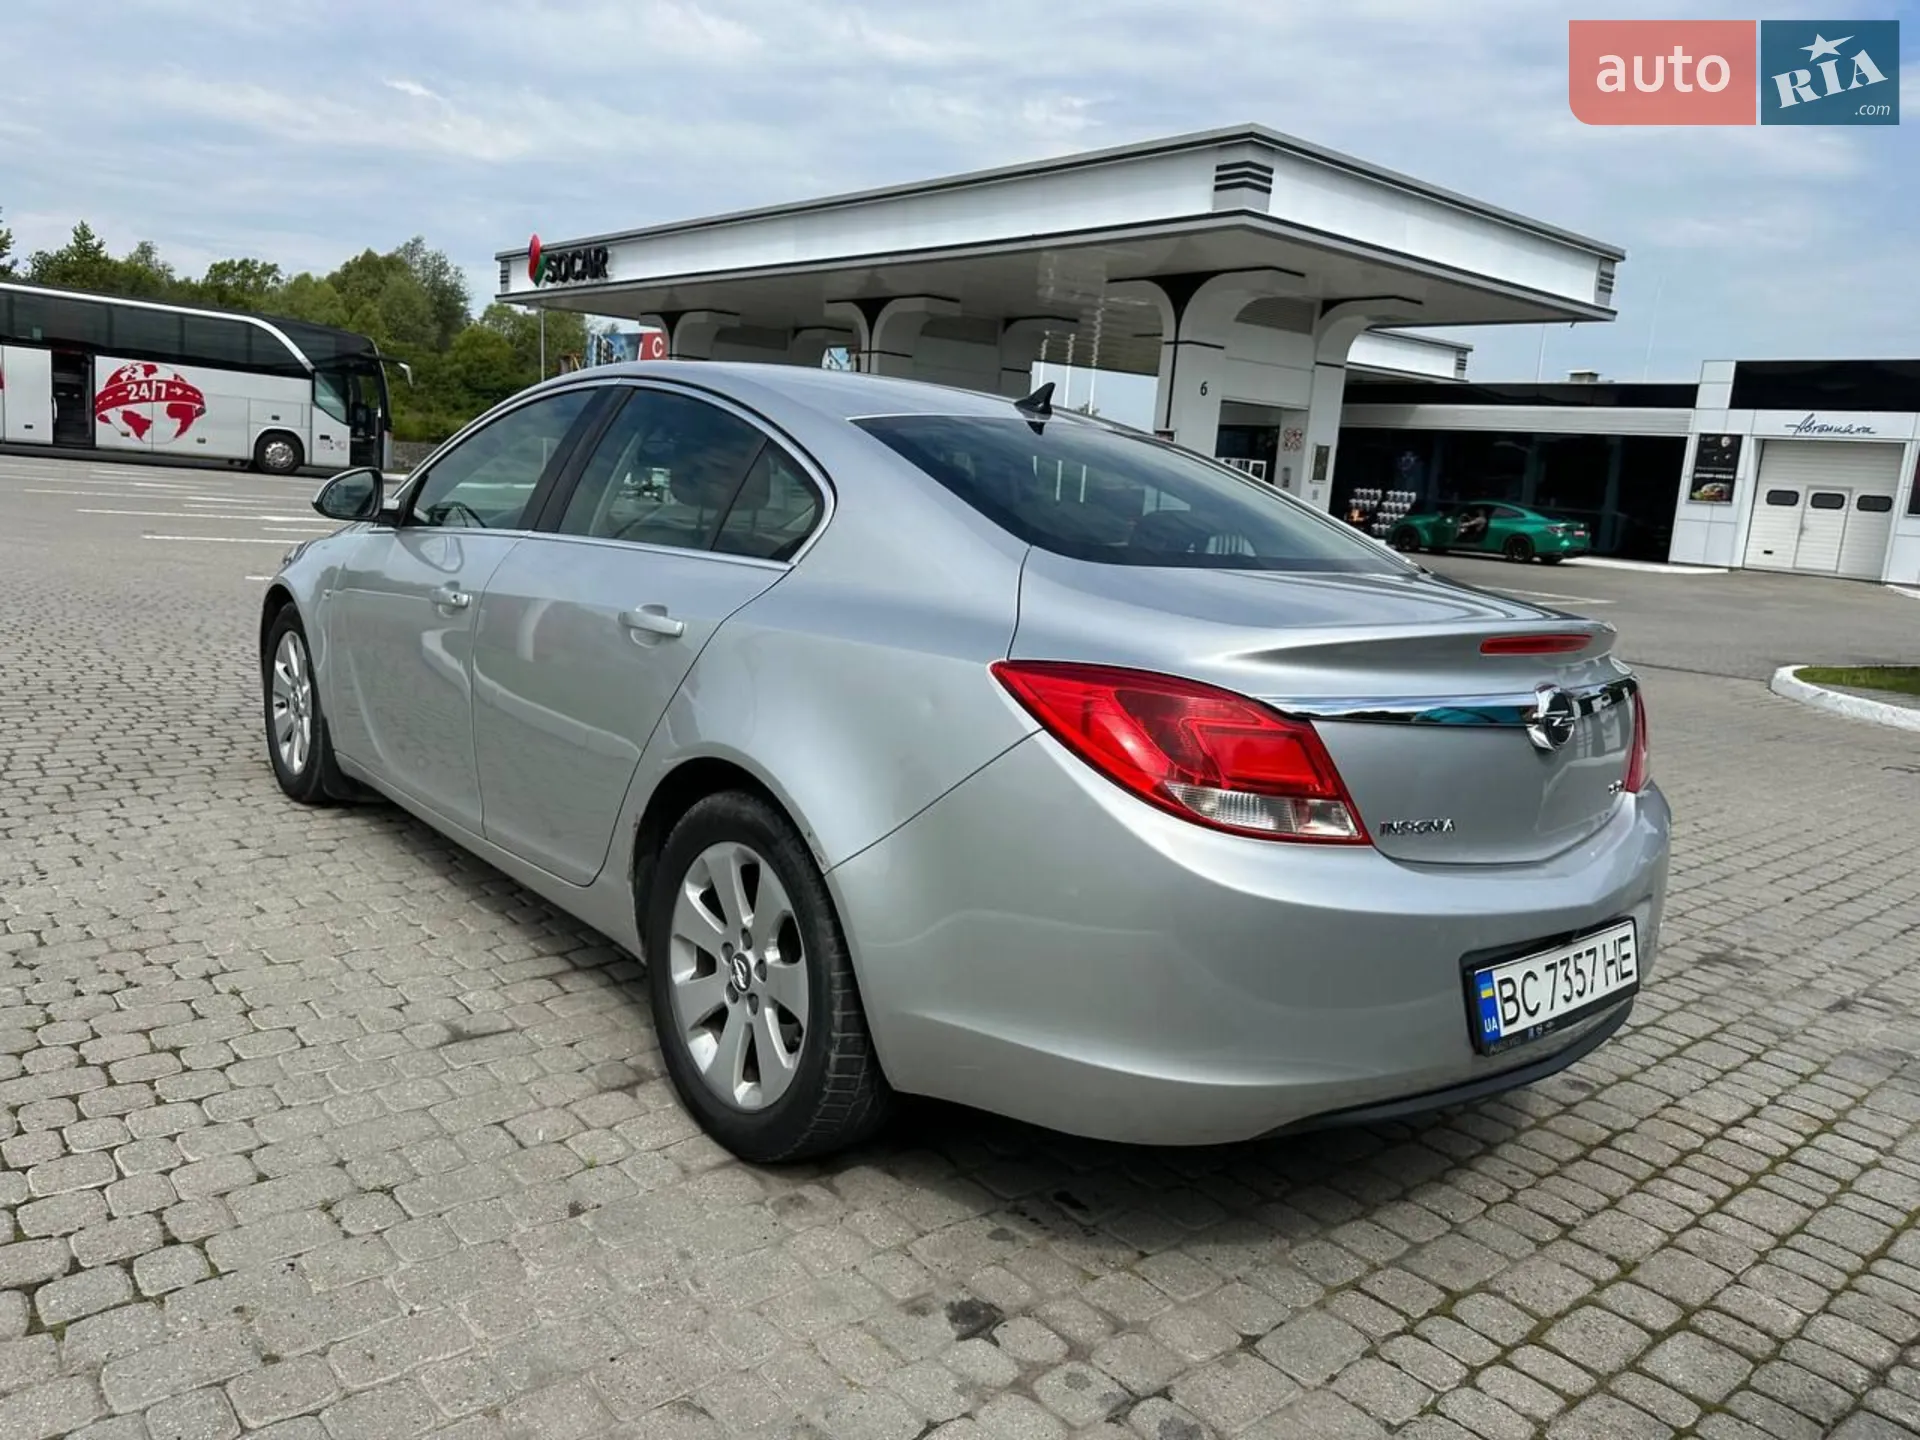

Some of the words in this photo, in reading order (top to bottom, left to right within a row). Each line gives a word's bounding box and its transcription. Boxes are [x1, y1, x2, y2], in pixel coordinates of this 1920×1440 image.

[546, 245, 609, 284] SOCAR
[127, 381, 167, 401] 24/7
[1199, 381, 1208, 396] 6
[1545, 947, 1597, 1011] 7357
[1484, 1015, 1499, 1033] UA
